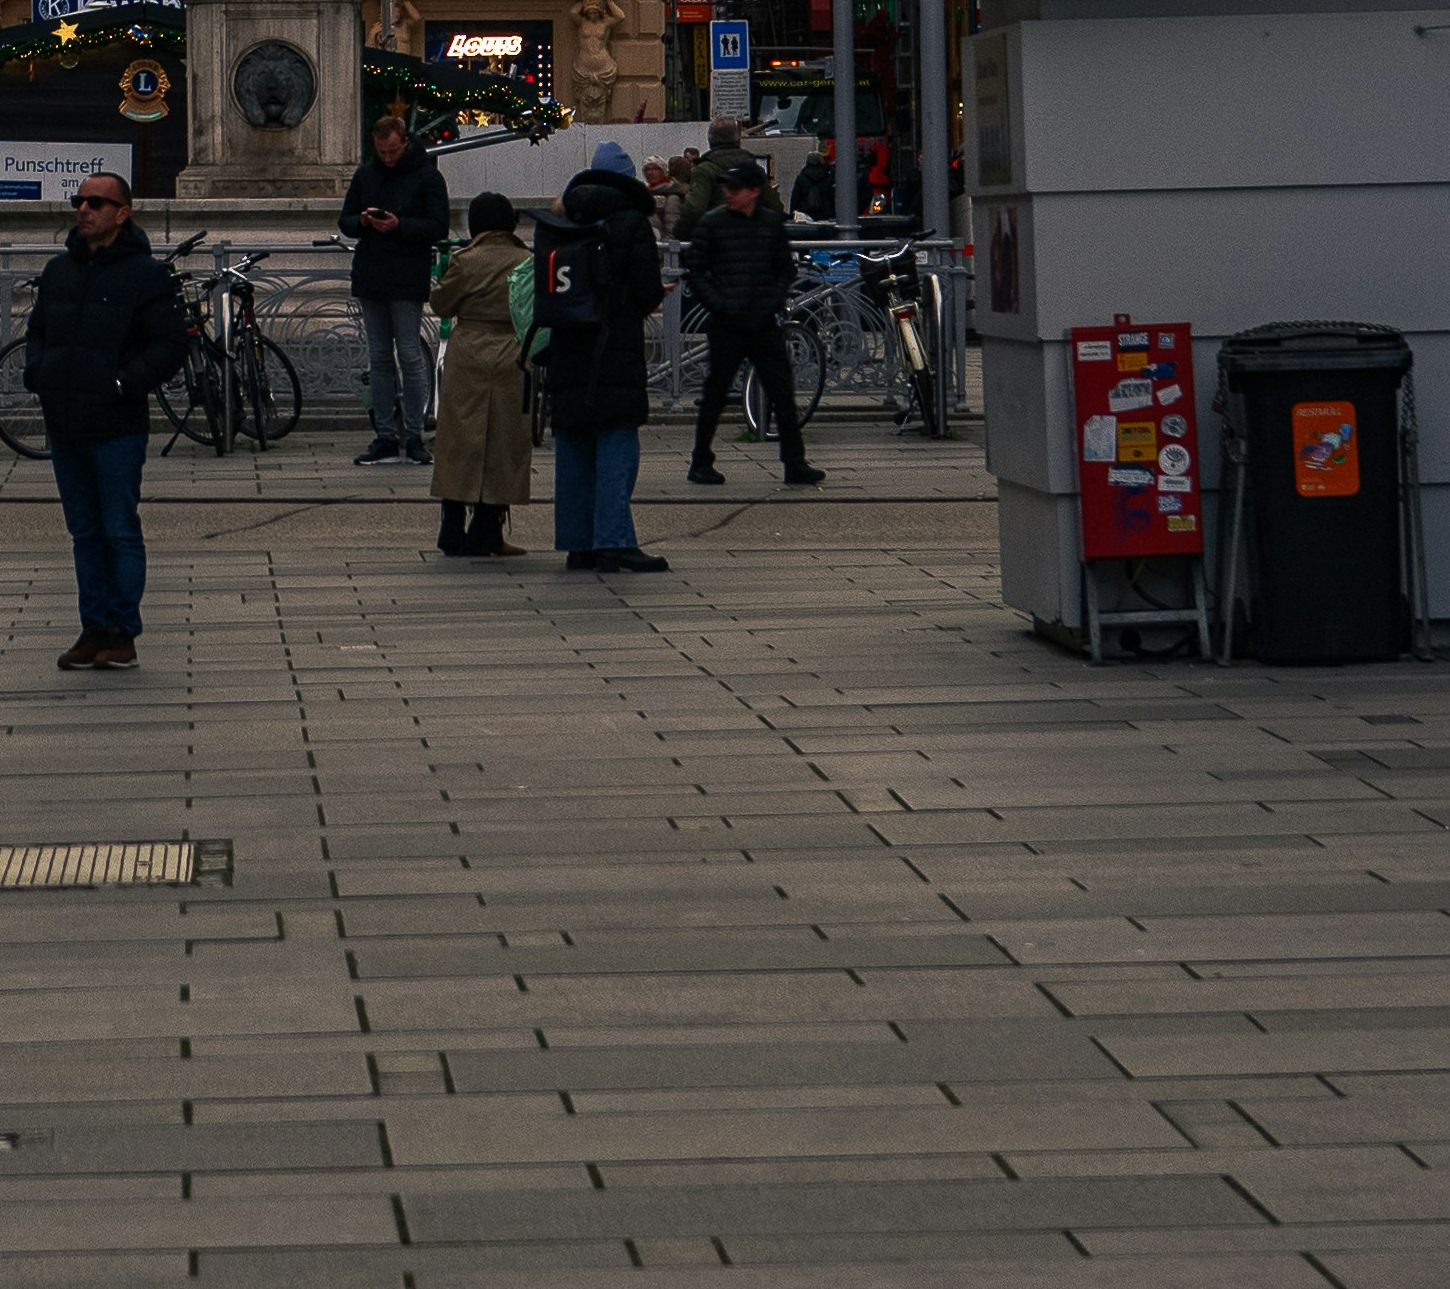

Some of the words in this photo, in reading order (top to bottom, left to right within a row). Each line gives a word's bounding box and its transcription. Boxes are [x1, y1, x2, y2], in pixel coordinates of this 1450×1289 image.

[139, 73, 151, 92] L
[5, 156, 104, 174] Punschtreff
[61, 178, 79, 188] am
